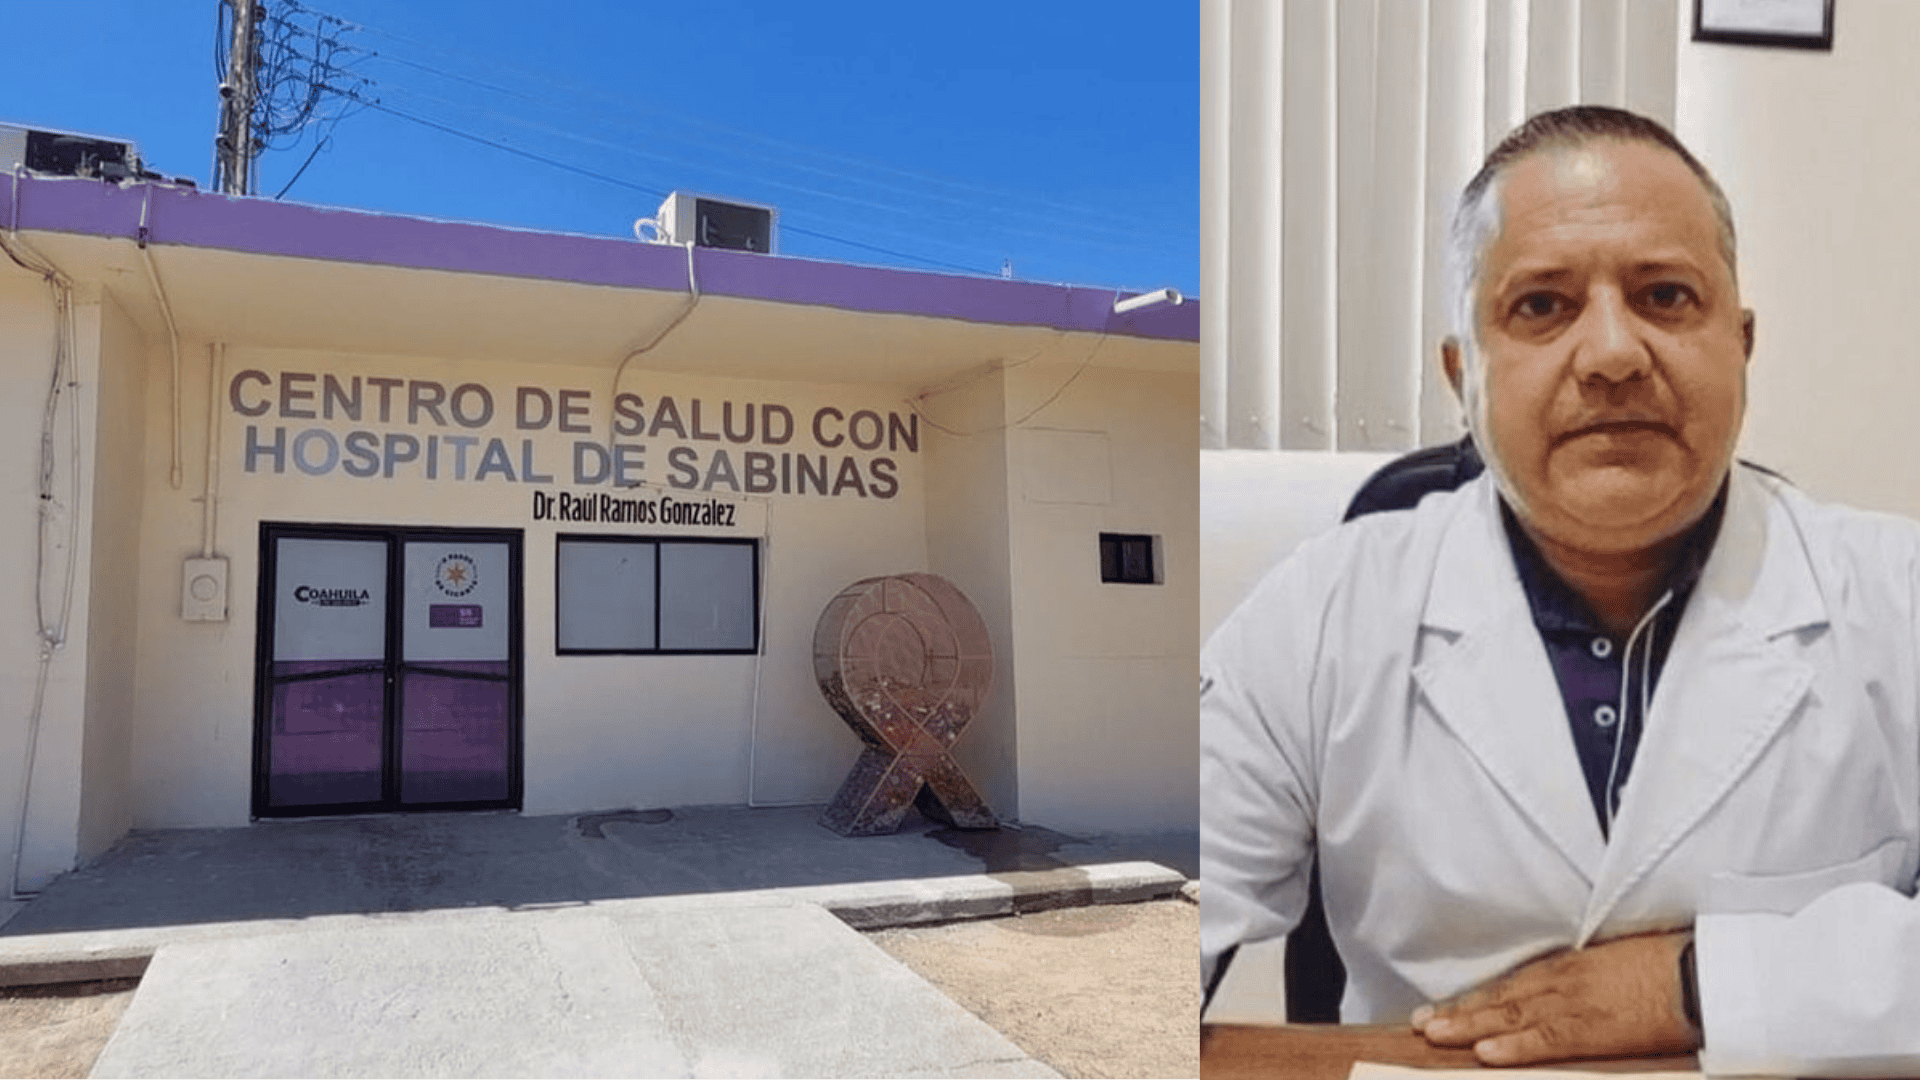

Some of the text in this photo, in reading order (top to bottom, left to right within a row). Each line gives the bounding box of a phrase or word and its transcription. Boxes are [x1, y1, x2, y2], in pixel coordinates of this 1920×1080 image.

[229, 369, 919, 453] CENTRO DE SALUD CON
[244, 425, 899, 499] HOSPITAL DE SABINAS
[533, 490, 736, 527] Dr. Raúl Ramos González
[294, 585, 370, 602] COAHUILA
